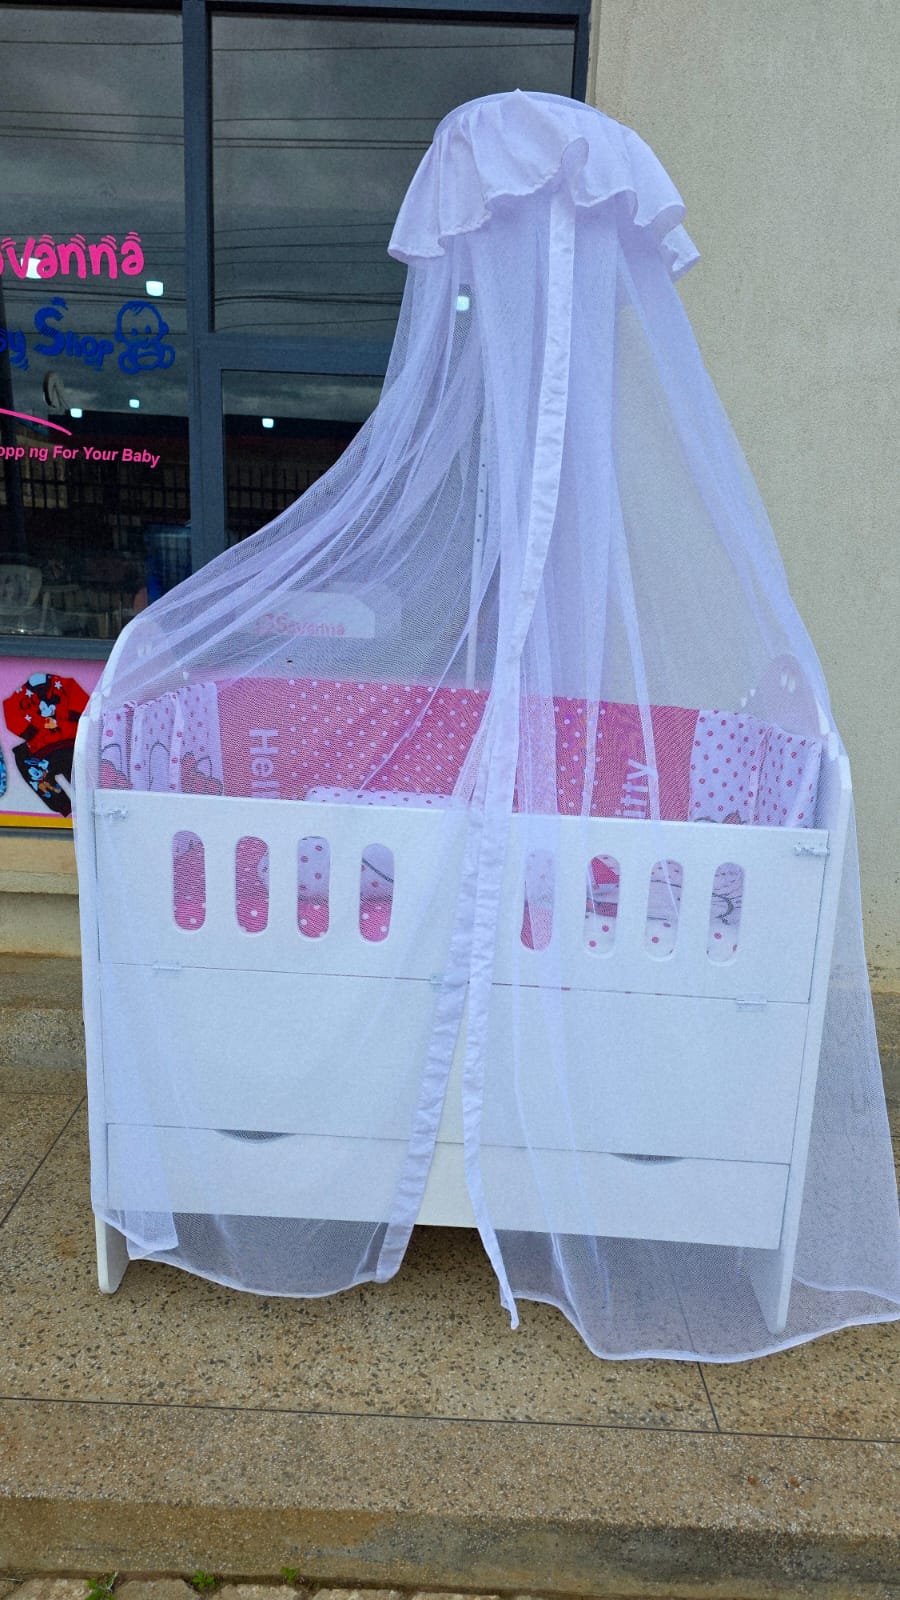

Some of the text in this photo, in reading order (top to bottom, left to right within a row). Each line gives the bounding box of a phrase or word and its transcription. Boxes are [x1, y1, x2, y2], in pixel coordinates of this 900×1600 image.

[0, 234, 145, 279] vanna
[53, 445, 79, 458] For
[83, 446, 119, 460] Your
[121, 448, 161, 468] Baby
